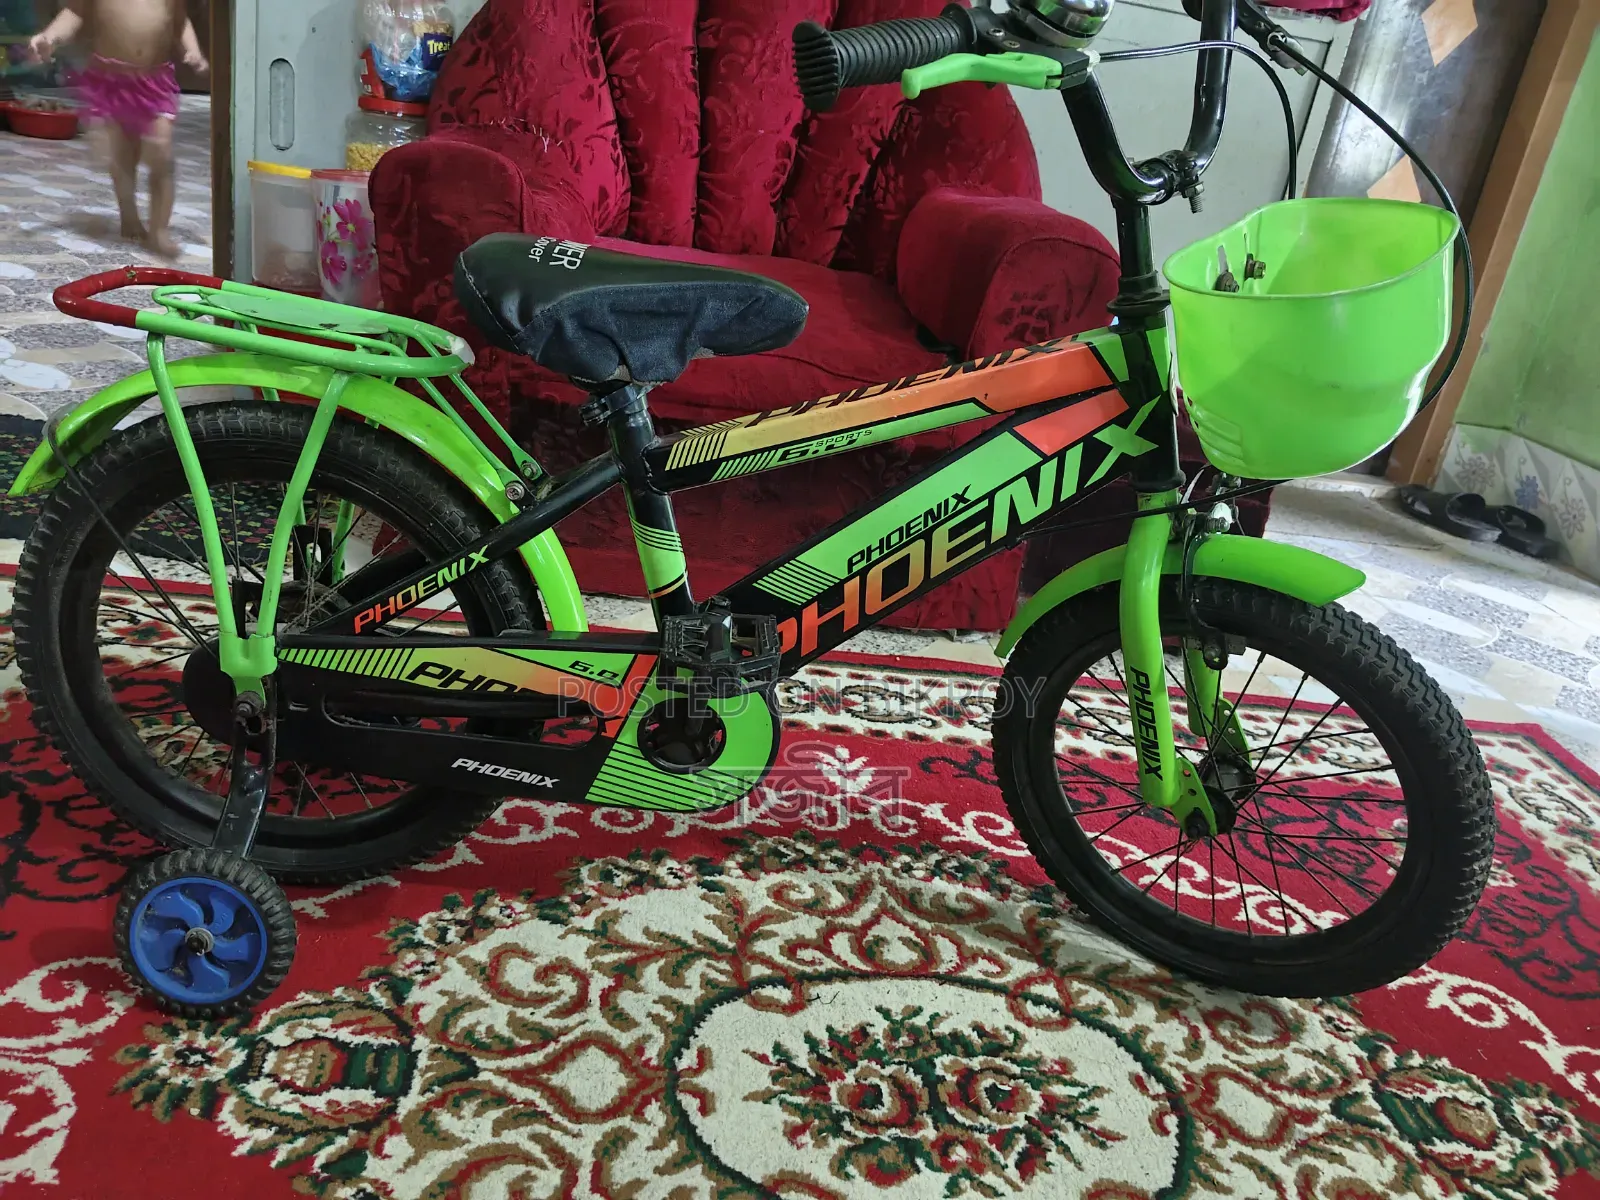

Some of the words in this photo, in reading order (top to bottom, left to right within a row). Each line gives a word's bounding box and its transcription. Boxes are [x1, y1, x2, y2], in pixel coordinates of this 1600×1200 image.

[815, 429, 873, 448] SPORTS
[846, 483, 972, 575] PHOENIX
[353, 544, 490, 634] PHOENIX
[568, 660, 620, 680] 6.0
[1128, 666, 1164, 781] PHOENIX
[451, 757, 560, 789] PHOENIX
